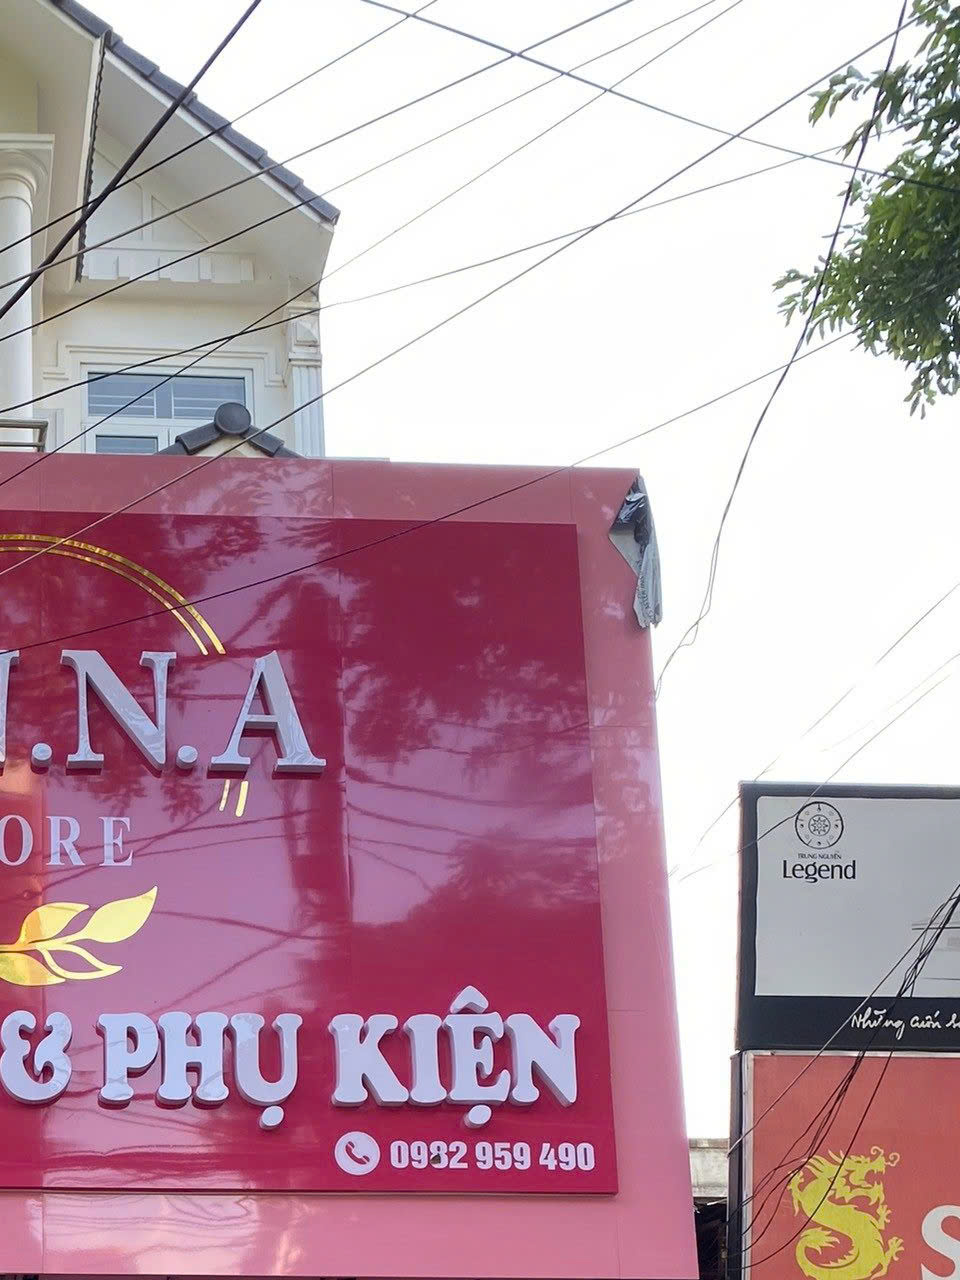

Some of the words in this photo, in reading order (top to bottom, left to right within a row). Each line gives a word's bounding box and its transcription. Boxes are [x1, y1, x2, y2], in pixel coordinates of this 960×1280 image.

[783, 860, 856, 883] Legend
[0, 1010, 73, 1103] &
[97, 1012, 303, 1129] PHỤ
[329, 985, 581, 1127] KIỆN
[390, 1140, 469, 1170] 0982
[475, 1141, 531, 1170] 959
[539, 1142, 595, 1173] 490
